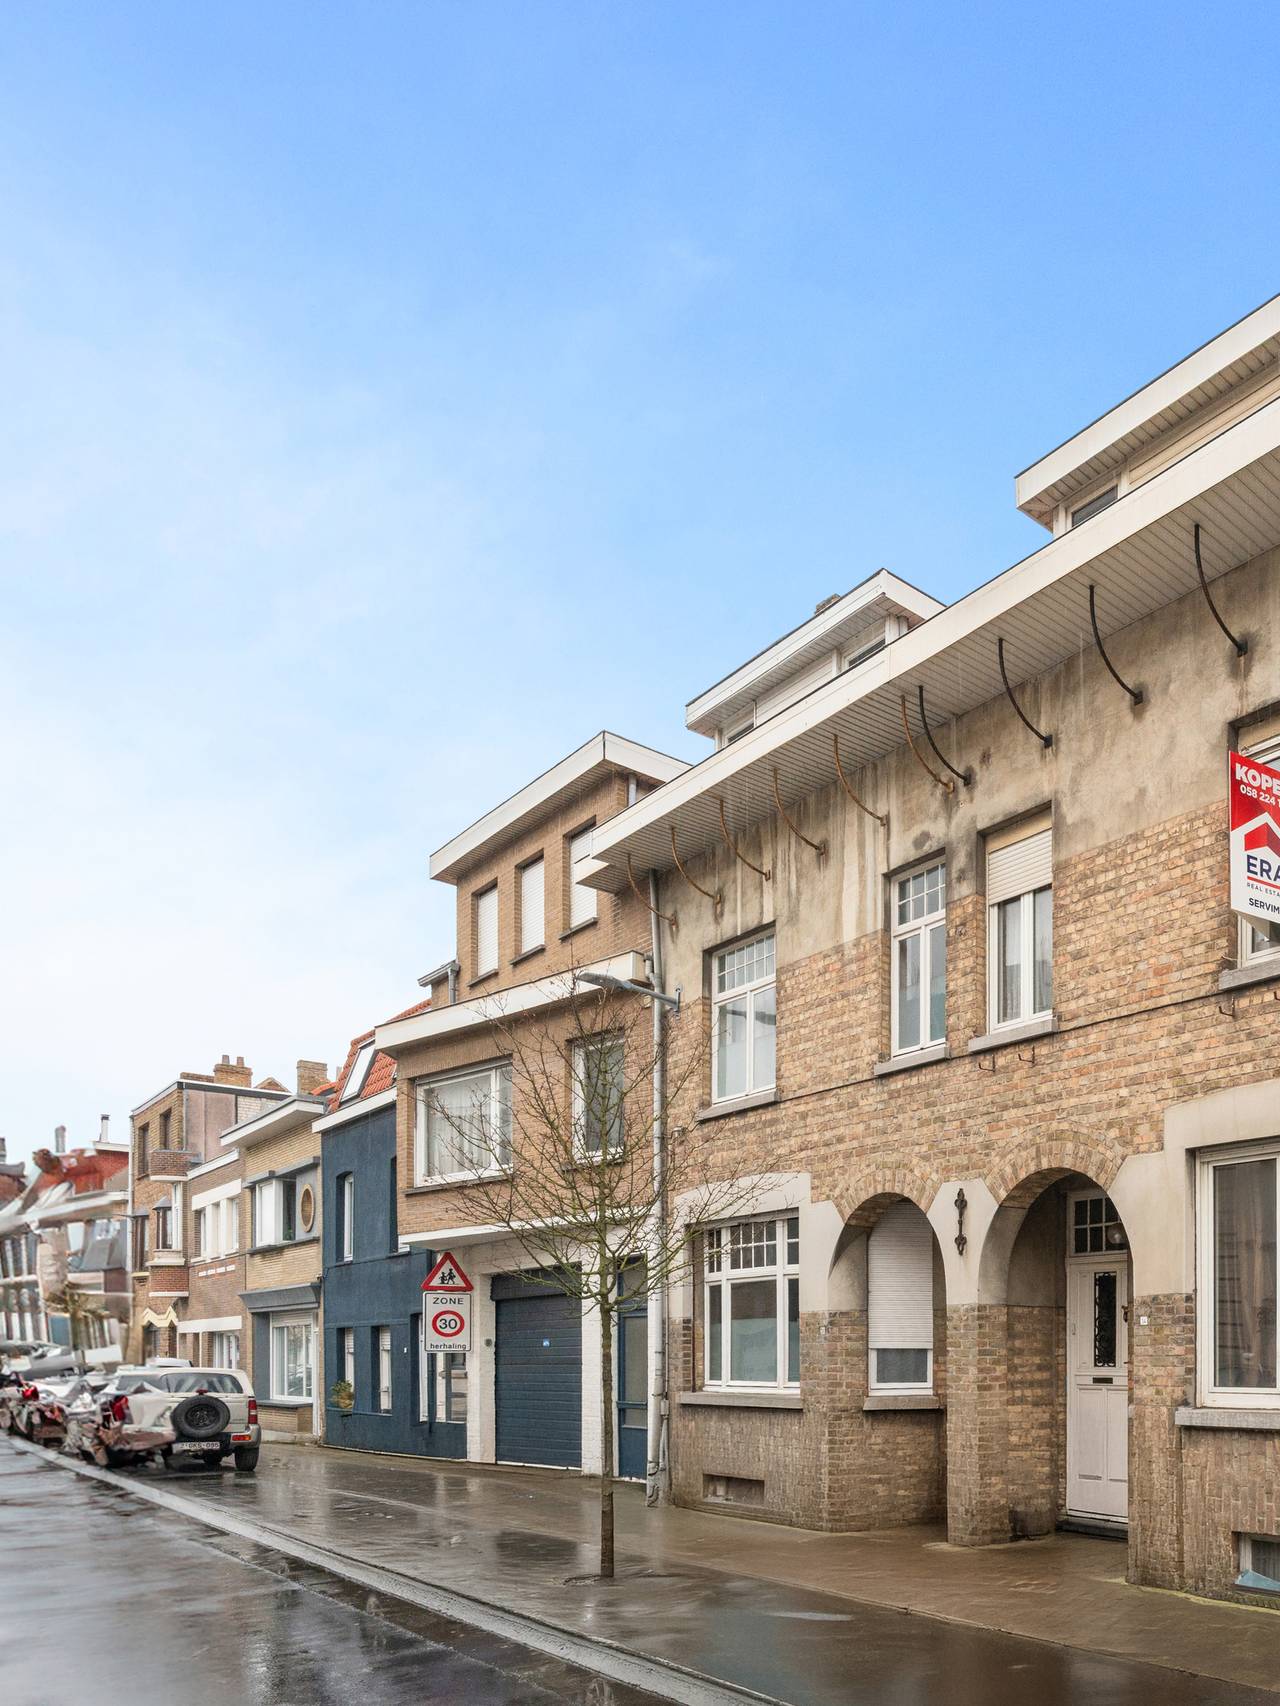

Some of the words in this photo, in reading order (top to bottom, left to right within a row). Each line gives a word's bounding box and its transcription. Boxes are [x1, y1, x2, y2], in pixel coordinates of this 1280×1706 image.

[1240, 784, 1258, 798] 058
[1259, 791, 1276, 805] 224
[1247, 882, 1263, 893] REAL
[433, 1297, 464, 1305] ZONE
[439, 1318, 458, 1330] 30
[430, 1343, 467, 1351] herhaling
